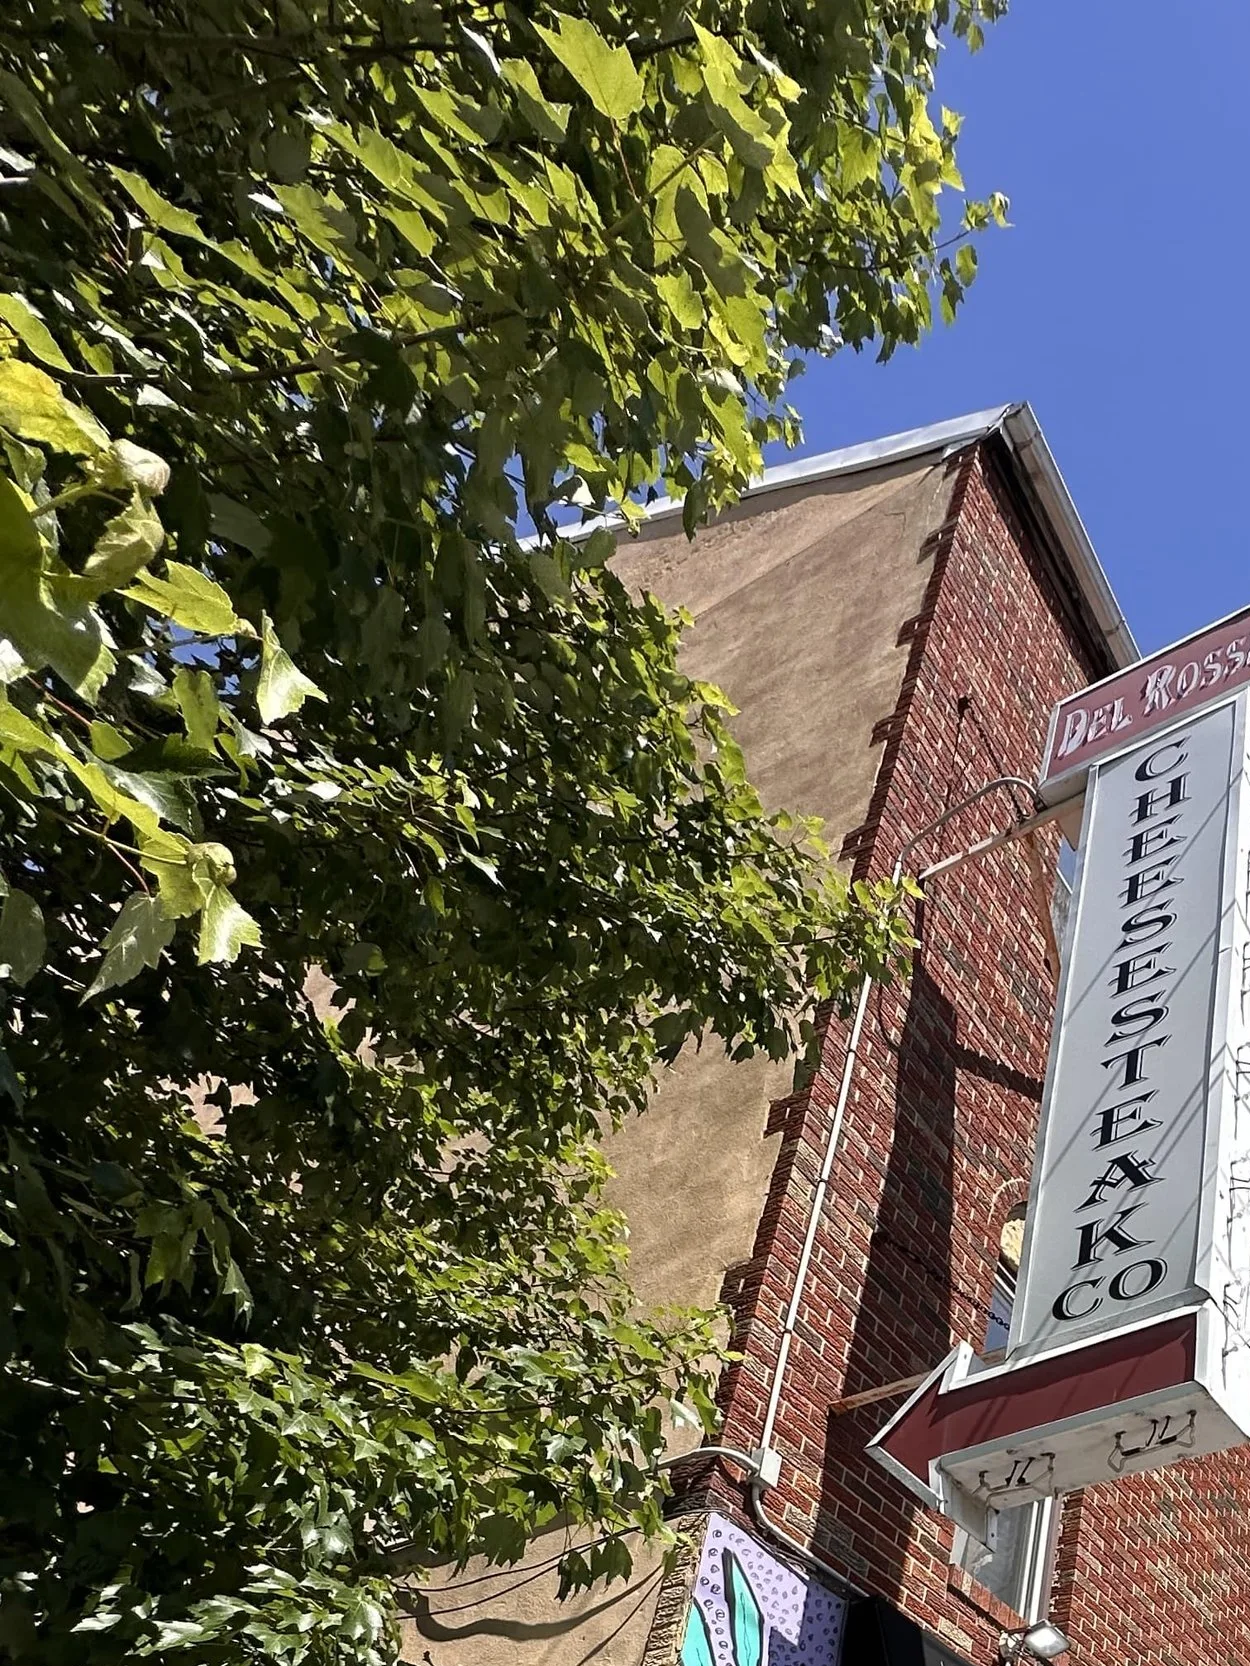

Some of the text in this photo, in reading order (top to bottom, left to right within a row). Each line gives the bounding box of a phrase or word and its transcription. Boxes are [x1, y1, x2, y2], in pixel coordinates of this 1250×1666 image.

[1056, 696, 1134, 760] DEL
[1072, 736, 1193, 1273] CHEESESTEAK
[1051, 1256, 1168, 1321] CO
